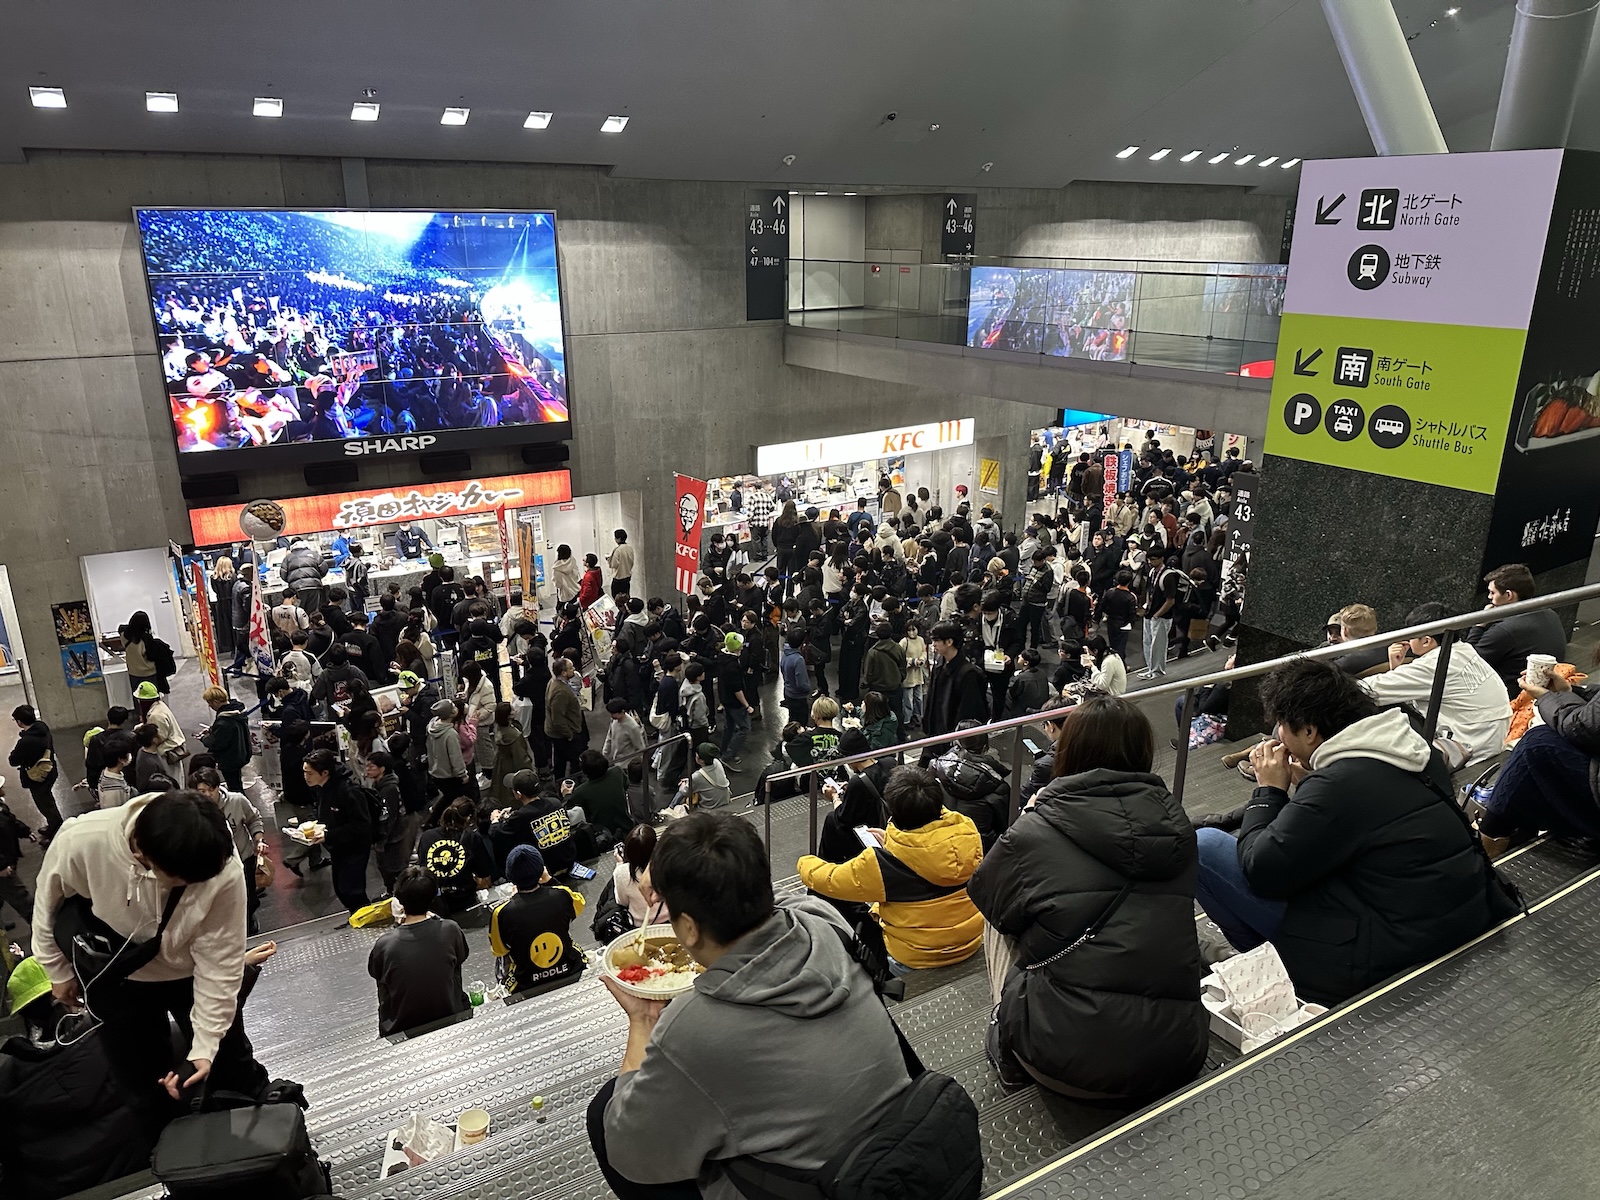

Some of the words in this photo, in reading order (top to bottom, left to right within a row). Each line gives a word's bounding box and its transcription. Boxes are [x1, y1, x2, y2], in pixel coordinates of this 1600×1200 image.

[1362, 194, 1393, 225] 北
[1402, 193, 1463, 210] 北ゲート
[1400, 212, 1429, 226] North
[1434, 213, 1460, 226] Gate
[1394, 253, 1442, 270] 地下鉄
[1391, 271, 1432, 288] Subway
[1339, 352, 1368, 383] 南
[1376, 355, 1433, 375] 南ゲート
[1373, 372, 1402, 388] South
[1406, 375, 1431, 391] Gate
[1293, 402, 1313, 426] P
[1333, 404, 1359, 417] TAXI
[1415, 417, 1488, 441] シャトルバス
[343, 434, 437, 456] SHARP
[882, 430, 925, 454] KFC
[1412, 434, 1450, 451] Shuttle
[1454, 438, 1474, 455] Bus
[675, 541, 698, 560] KFC
[532, 963, 569, 982] RIDDLE
